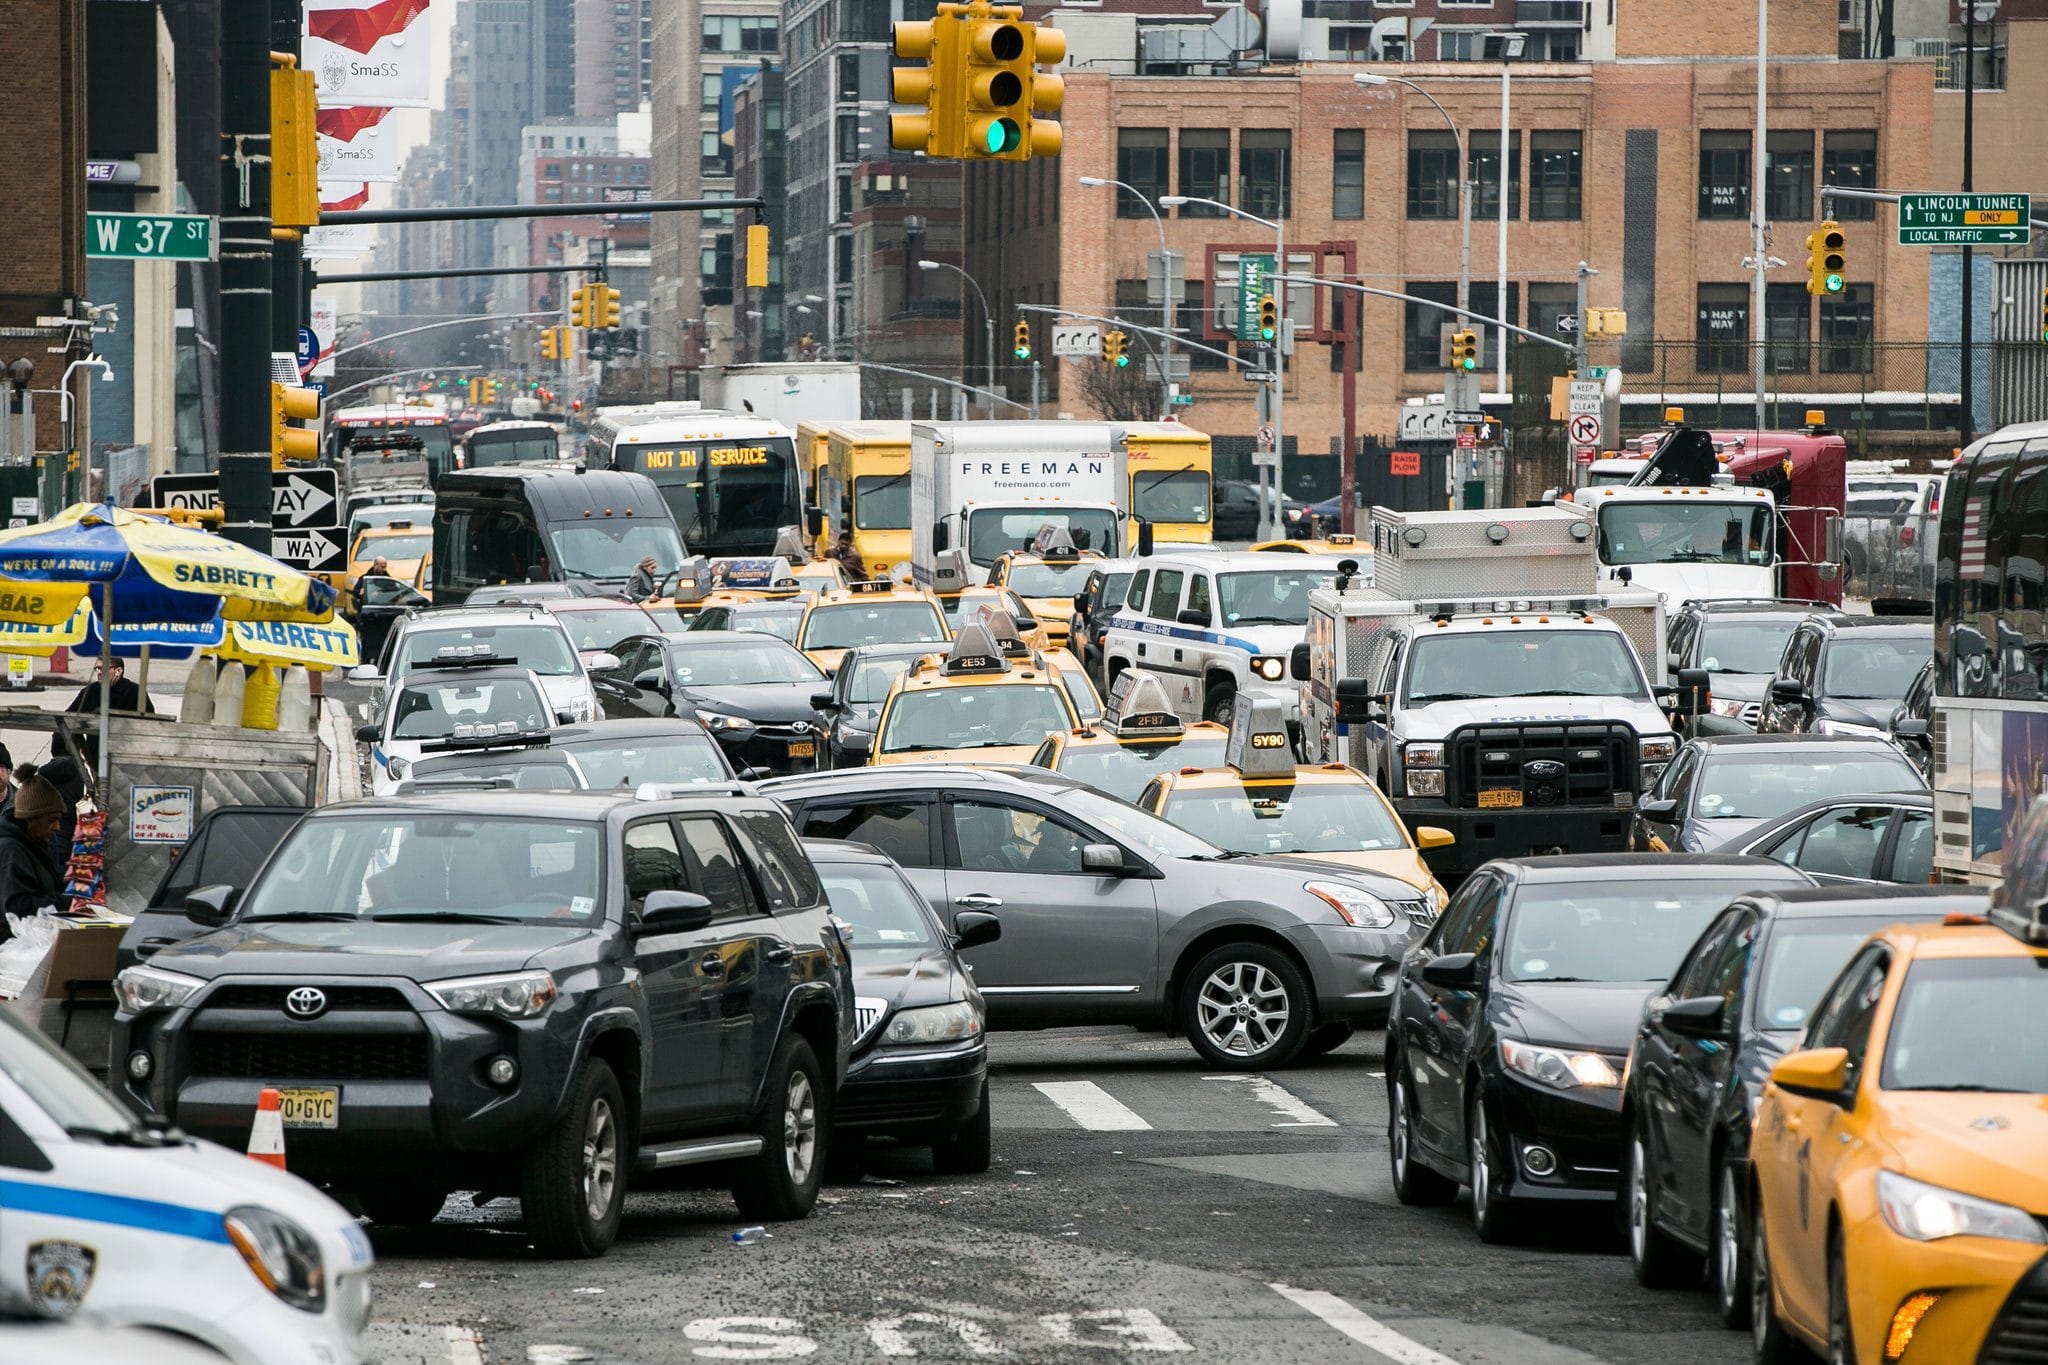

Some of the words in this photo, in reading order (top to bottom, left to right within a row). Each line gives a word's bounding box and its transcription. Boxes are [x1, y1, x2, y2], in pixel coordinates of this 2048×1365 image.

[350, 62, 399, 77] SmaSS
[336, 148, 374, 160] SmaSS
[1712, 196, 1736, 205] WAY
[1918, 197, 1970, 210] LINCOLN
[1976, 197, 2025, 210] TUNNEL
[1924, 213, 1936, 223] TO
[1941, 213, 1954, 223] NJ
[1980, 213, 2002, 223] ONLY
[96, 219, 121, 252] W
[135, 219, 173, 254] 37
[186, 221, 205, 239] ST
[1909, 231, 1940, 241] LOCAL
[1944, 231, 1983, 241] TRAFFIC
[1711, 320, 1734, 329] WAY
[1574, 402, 1597, 410] CLEAR
[646, 451, 674, 468] NOT
[679, 450, 697, 467] IN
[709, 446, 768, 466] SERVICE
[962, 462, 1102, 475] FREEMAN
[1394, 463, 1417, 471] PLOW
[994, 480, 1071, 489] freemanco.com
[287, 540, 328, 558] WAY
[3, 560, 38, 571] WE'RE
[41, 559, 56, 570] ON
[58, 560, 66, 570] A
[68, 560, 97, 571] ROLL
[99, 561, 115, 572] !!!
[174, 564, 277, 591] SABRETT
[862, 583, 883, 592] 8A71
[236, 621, 349, 655] SABRETT
[962, 657, 986, 667] 2E53
[1137, 716, 1165, 726] 2F87
[1490, 714, 1590, 723] POLICE
[1253, 735, 1285, 748] 5Y90
[1531, 762, 1558, 775] Ford
[136, 791, 188, 813] SABRETT
[1502, 790, 1521, 804] 1859
[304, 1098, 333, 1119] GYC
